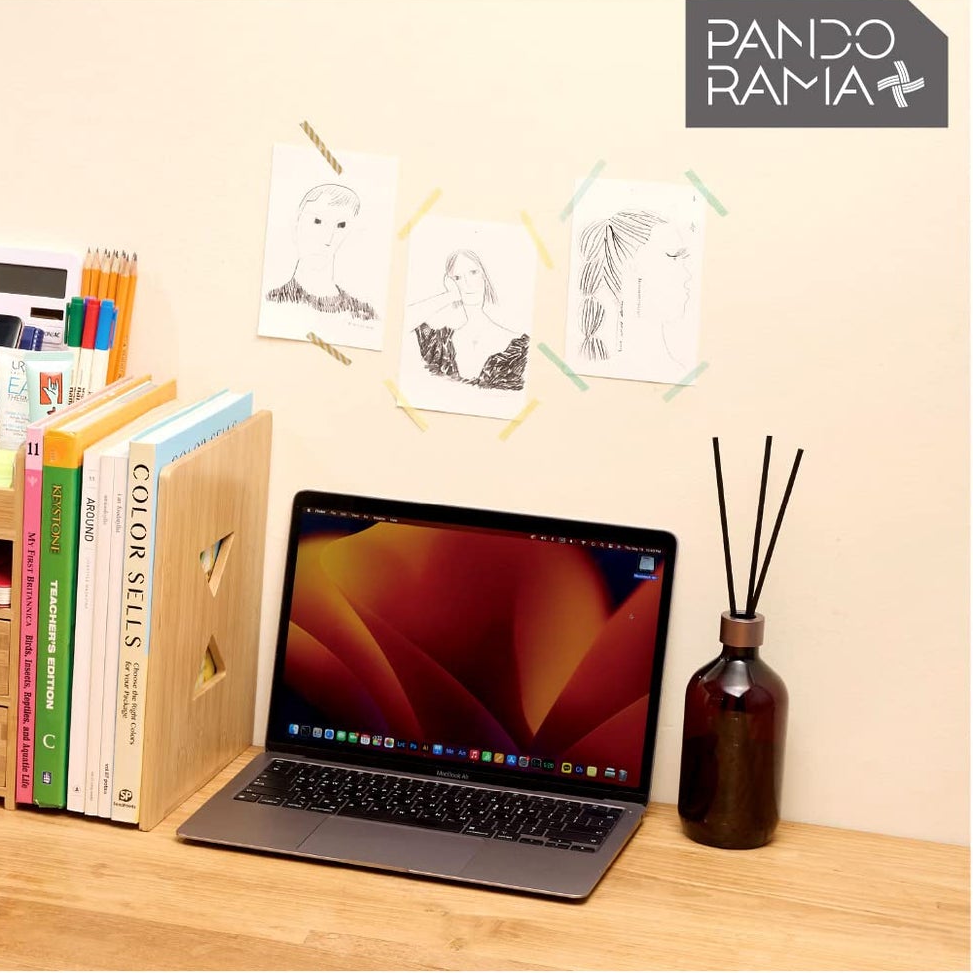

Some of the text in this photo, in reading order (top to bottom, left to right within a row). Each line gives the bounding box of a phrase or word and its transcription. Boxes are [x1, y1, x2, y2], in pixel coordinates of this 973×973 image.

[27, 442, 40, 456] 11
[50, 484, 62, 554] KEYSTONE
[84, 497, 96, 542] AROUND
[125, 463, 150, 649] COLOR SELLS
[45, 580, 59, 710] TEACHER'S EDITION
[123, 673, 131, 689] Your
[20, 634, 33, 789] Birds, Insects, Reptiles, and Aquatic Life
[121, 690, 130, 719] Package
[129, 662, 140, 746] Choose the Right Colors
[120, 790, 132, 801] SP
[436, 770, 460, 779] MacBook
